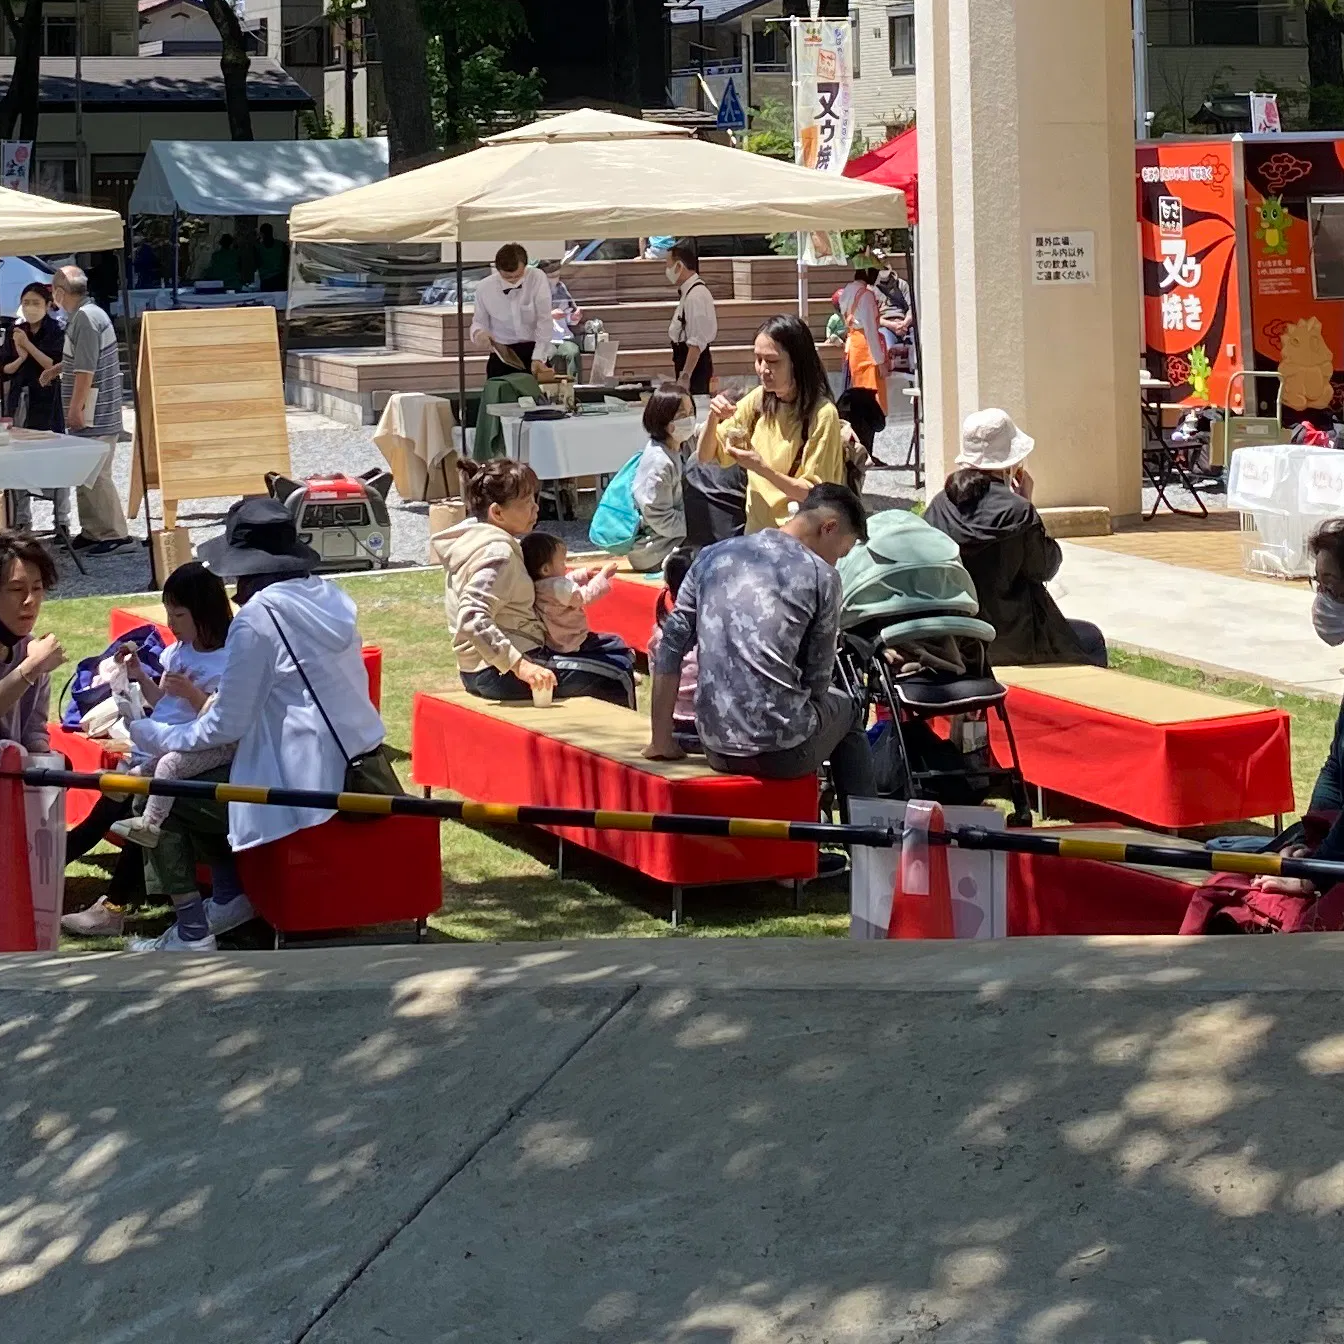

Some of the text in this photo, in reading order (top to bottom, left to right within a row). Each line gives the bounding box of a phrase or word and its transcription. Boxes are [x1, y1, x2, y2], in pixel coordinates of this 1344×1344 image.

[1036, 247, 1085, 257] ホール内以外
[1036, 259, 1077, 269] での飲食は
[1036, 270, 1090, 281] ご遠慮ください
[1161, 293, 1203, 331] 焼き
